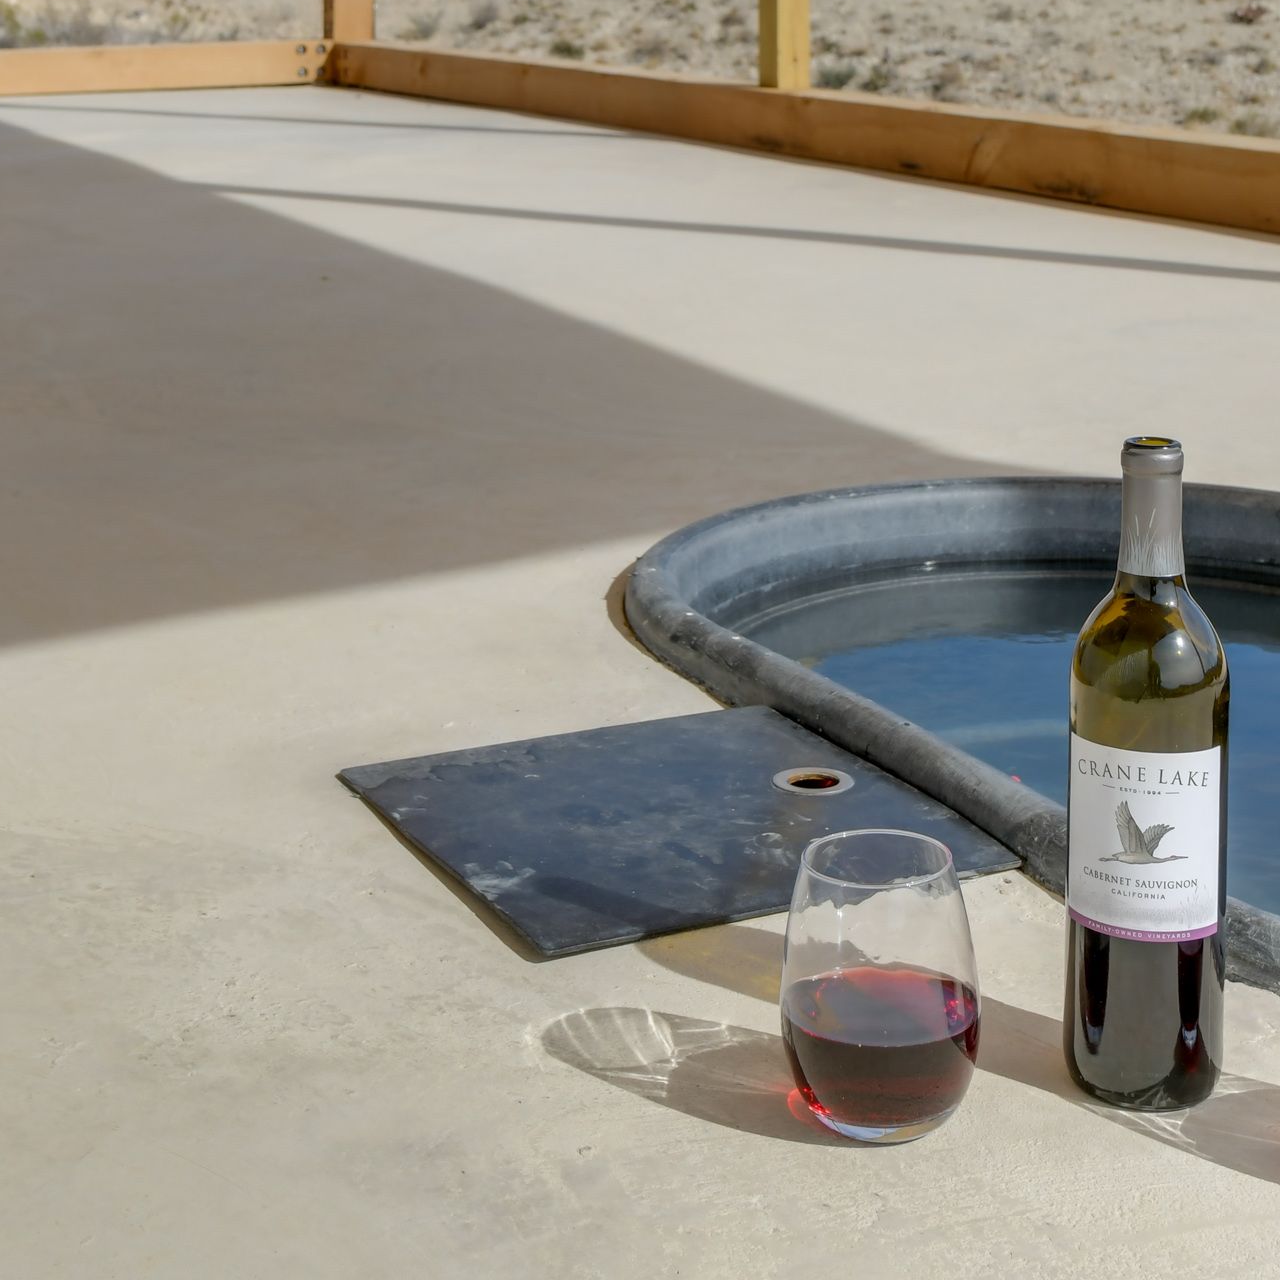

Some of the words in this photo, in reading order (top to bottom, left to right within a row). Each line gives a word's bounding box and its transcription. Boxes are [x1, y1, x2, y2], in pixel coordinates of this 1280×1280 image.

[1078, 758, 1146, 783] CRANE
[1159, 768, 1209, 788] LAKE
[1083, 866, 1132, 887] CABERNET
[1135, 878, 1198, 890] SAUVIGNON
[1111, 888, 1166, 900] CALIFORNIA
[1147, 932, 1191, 940] VINEYARDS
